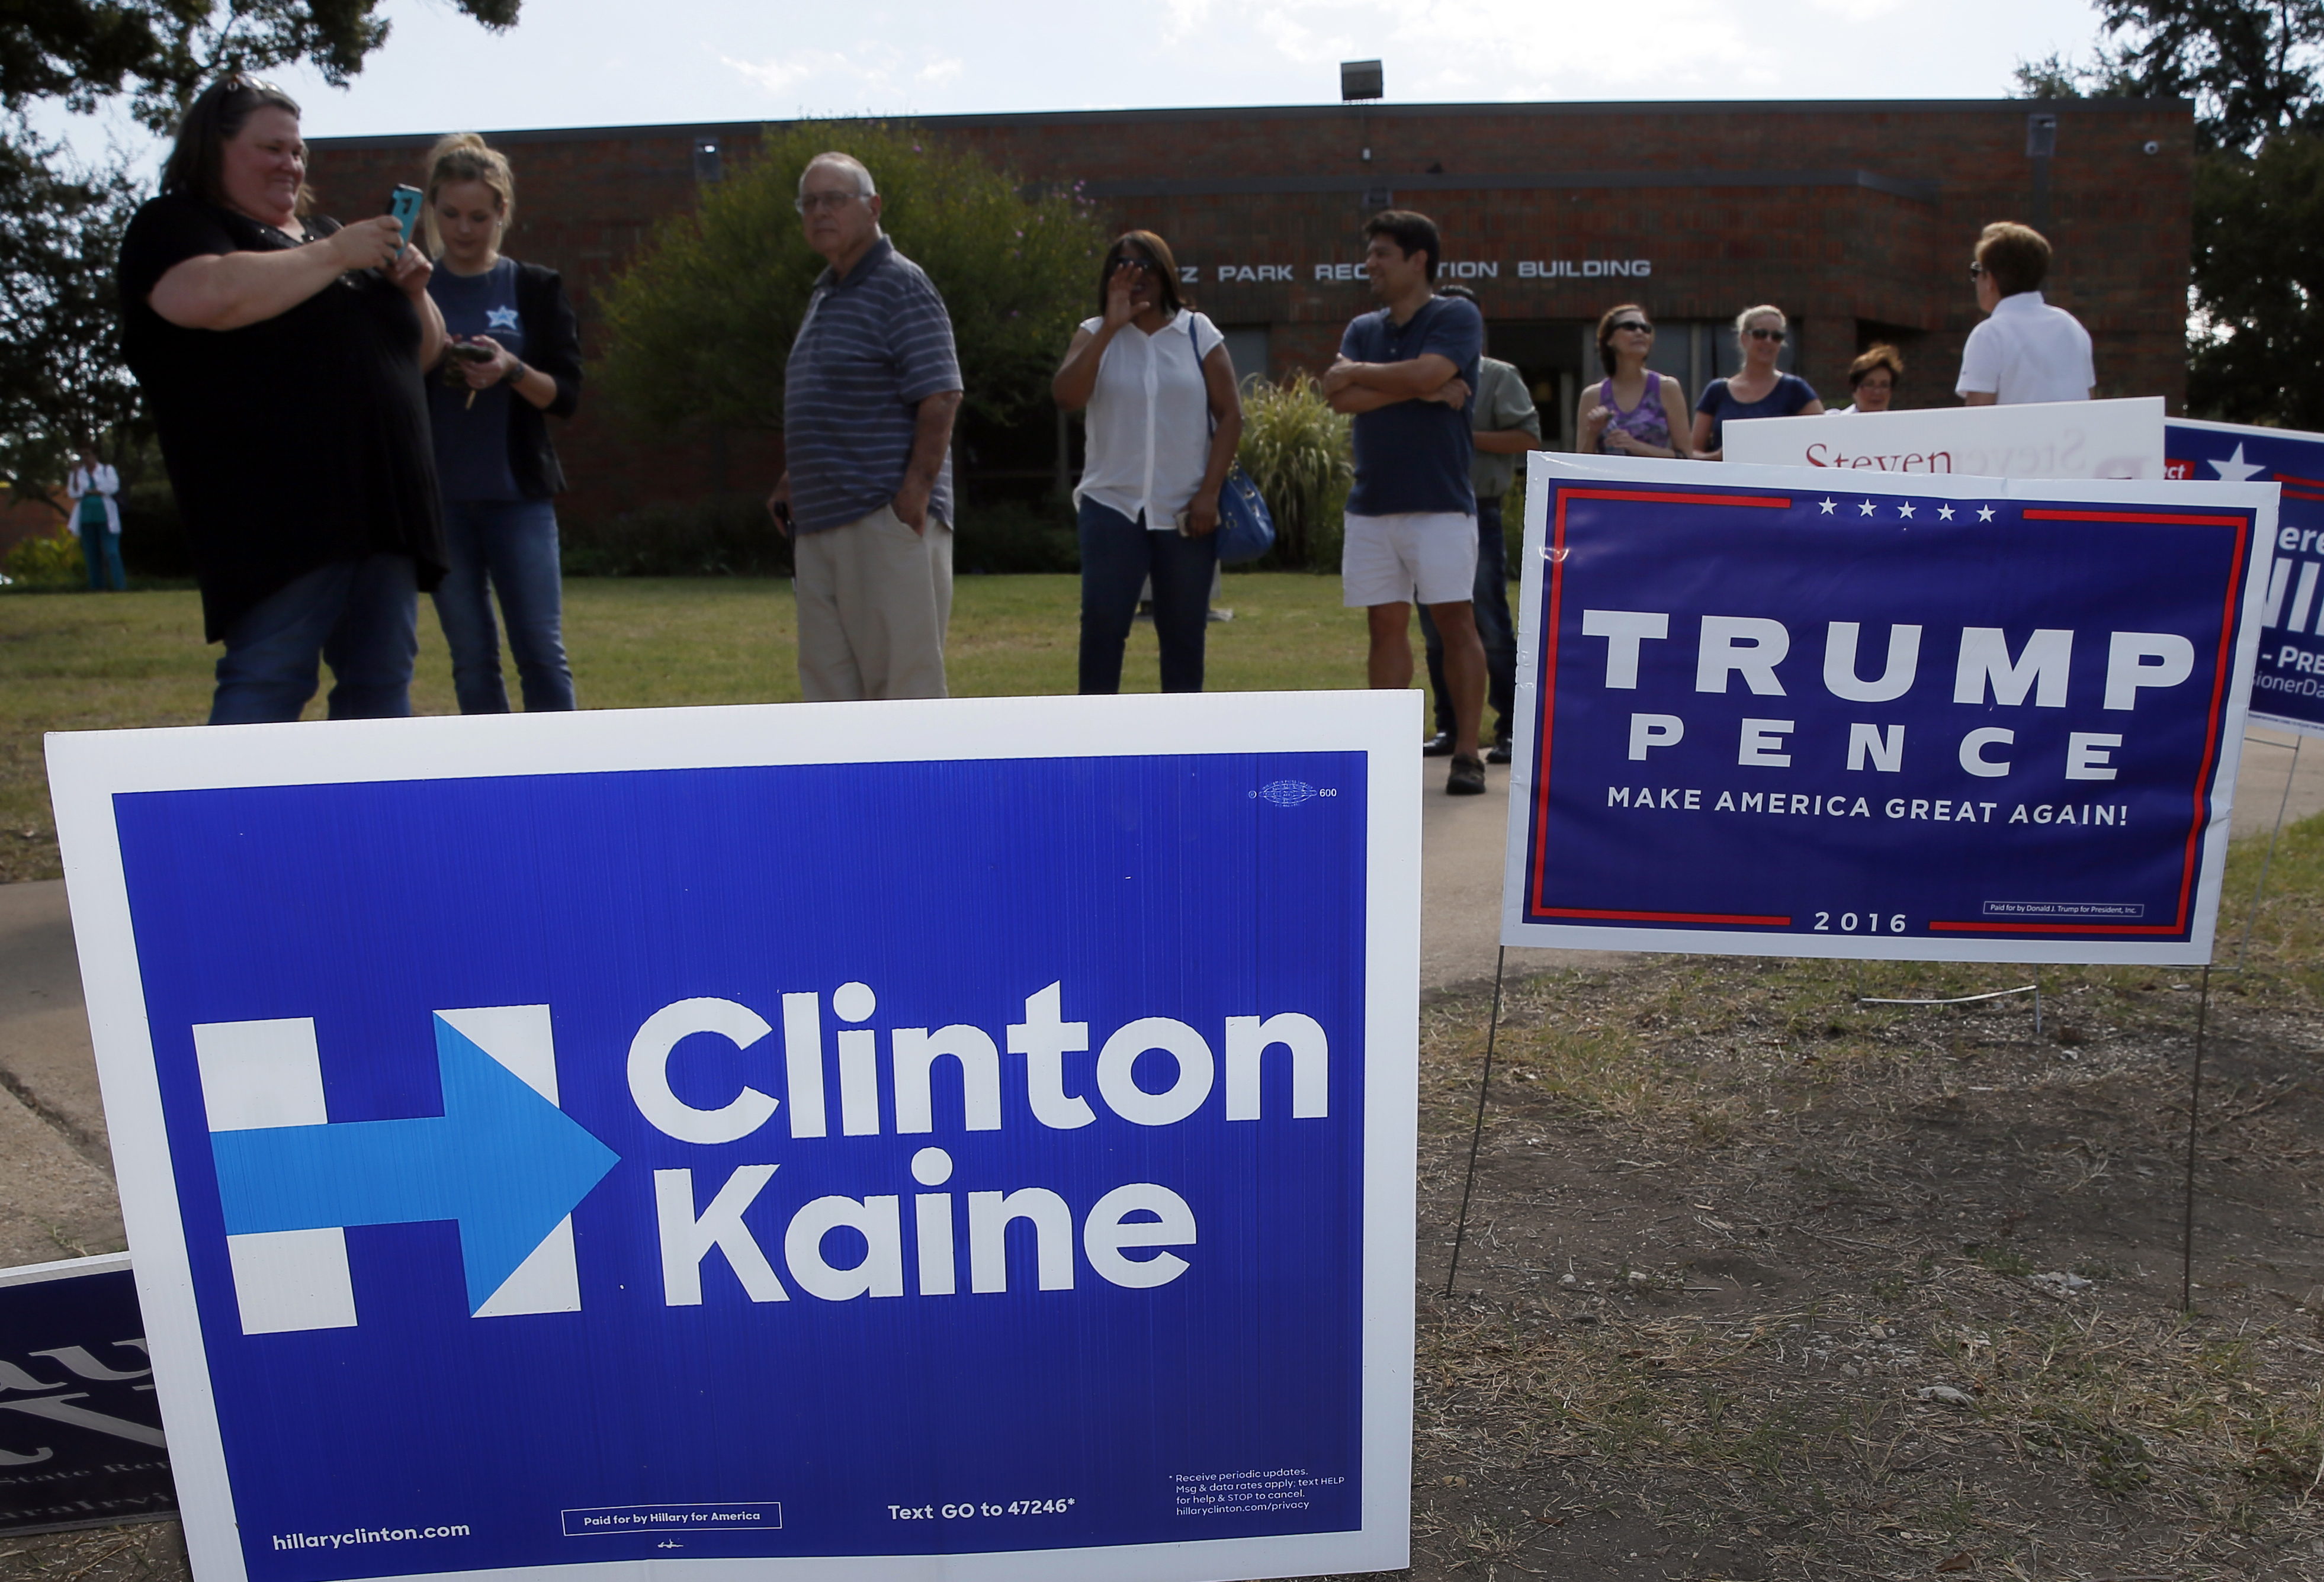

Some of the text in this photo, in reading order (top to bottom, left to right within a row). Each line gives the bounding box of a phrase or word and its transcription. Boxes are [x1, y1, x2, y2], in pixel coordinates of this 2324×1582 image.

[1218, 264, 1294, 282] PARK
[1314, 261, 1498, 281] RECTION
[1517, 259, 1652, 278] BUILDING
[1582, 609, 2195, 711] TRUMP
[1628, 713, 2123, 780] PENCE
[1319, 788, 1337, 797] 600
[1607, 786, 2129, 826] MAKE AMERICA GREAT AGAIN!
[1813, 911, 1906, 933] 2016
[627, 980, 1328, 1144] Clinton
[654, 1147, 1197, 1306] Kaine
[1176, 1468, 1308, 1483] Receive periodic updates.
[1176, 1484, 1196, 1494] Msg
[1209, 1483, 1234, 1491] data
[1236, 1481, 1262, 1490] rates
[1298, 1478, 1319, 1487] text
[1321, 1477, 1345, 1485] HELP
[1176, 1496, 1190, 1504] for
[1193, 1494, 1215, 1505] help
[1218, 1494, 1225, 1502] &
[1227, 1493, 1253, 1501] STOP
[1268, 1489, 1305, 1500] cancel.
[584, 1510, 760, 1526] Paid for by Hillary for America
[888, 1504, 934, 1520] Text
[942, 1503, 975, 1519] GO
[981, 1501, 1003, 1516] to
[1176, 1501, 1309, 1516] hillaryclinton.com/privacy
[272, 1524, 471, 1551] hillaryclinton.com
